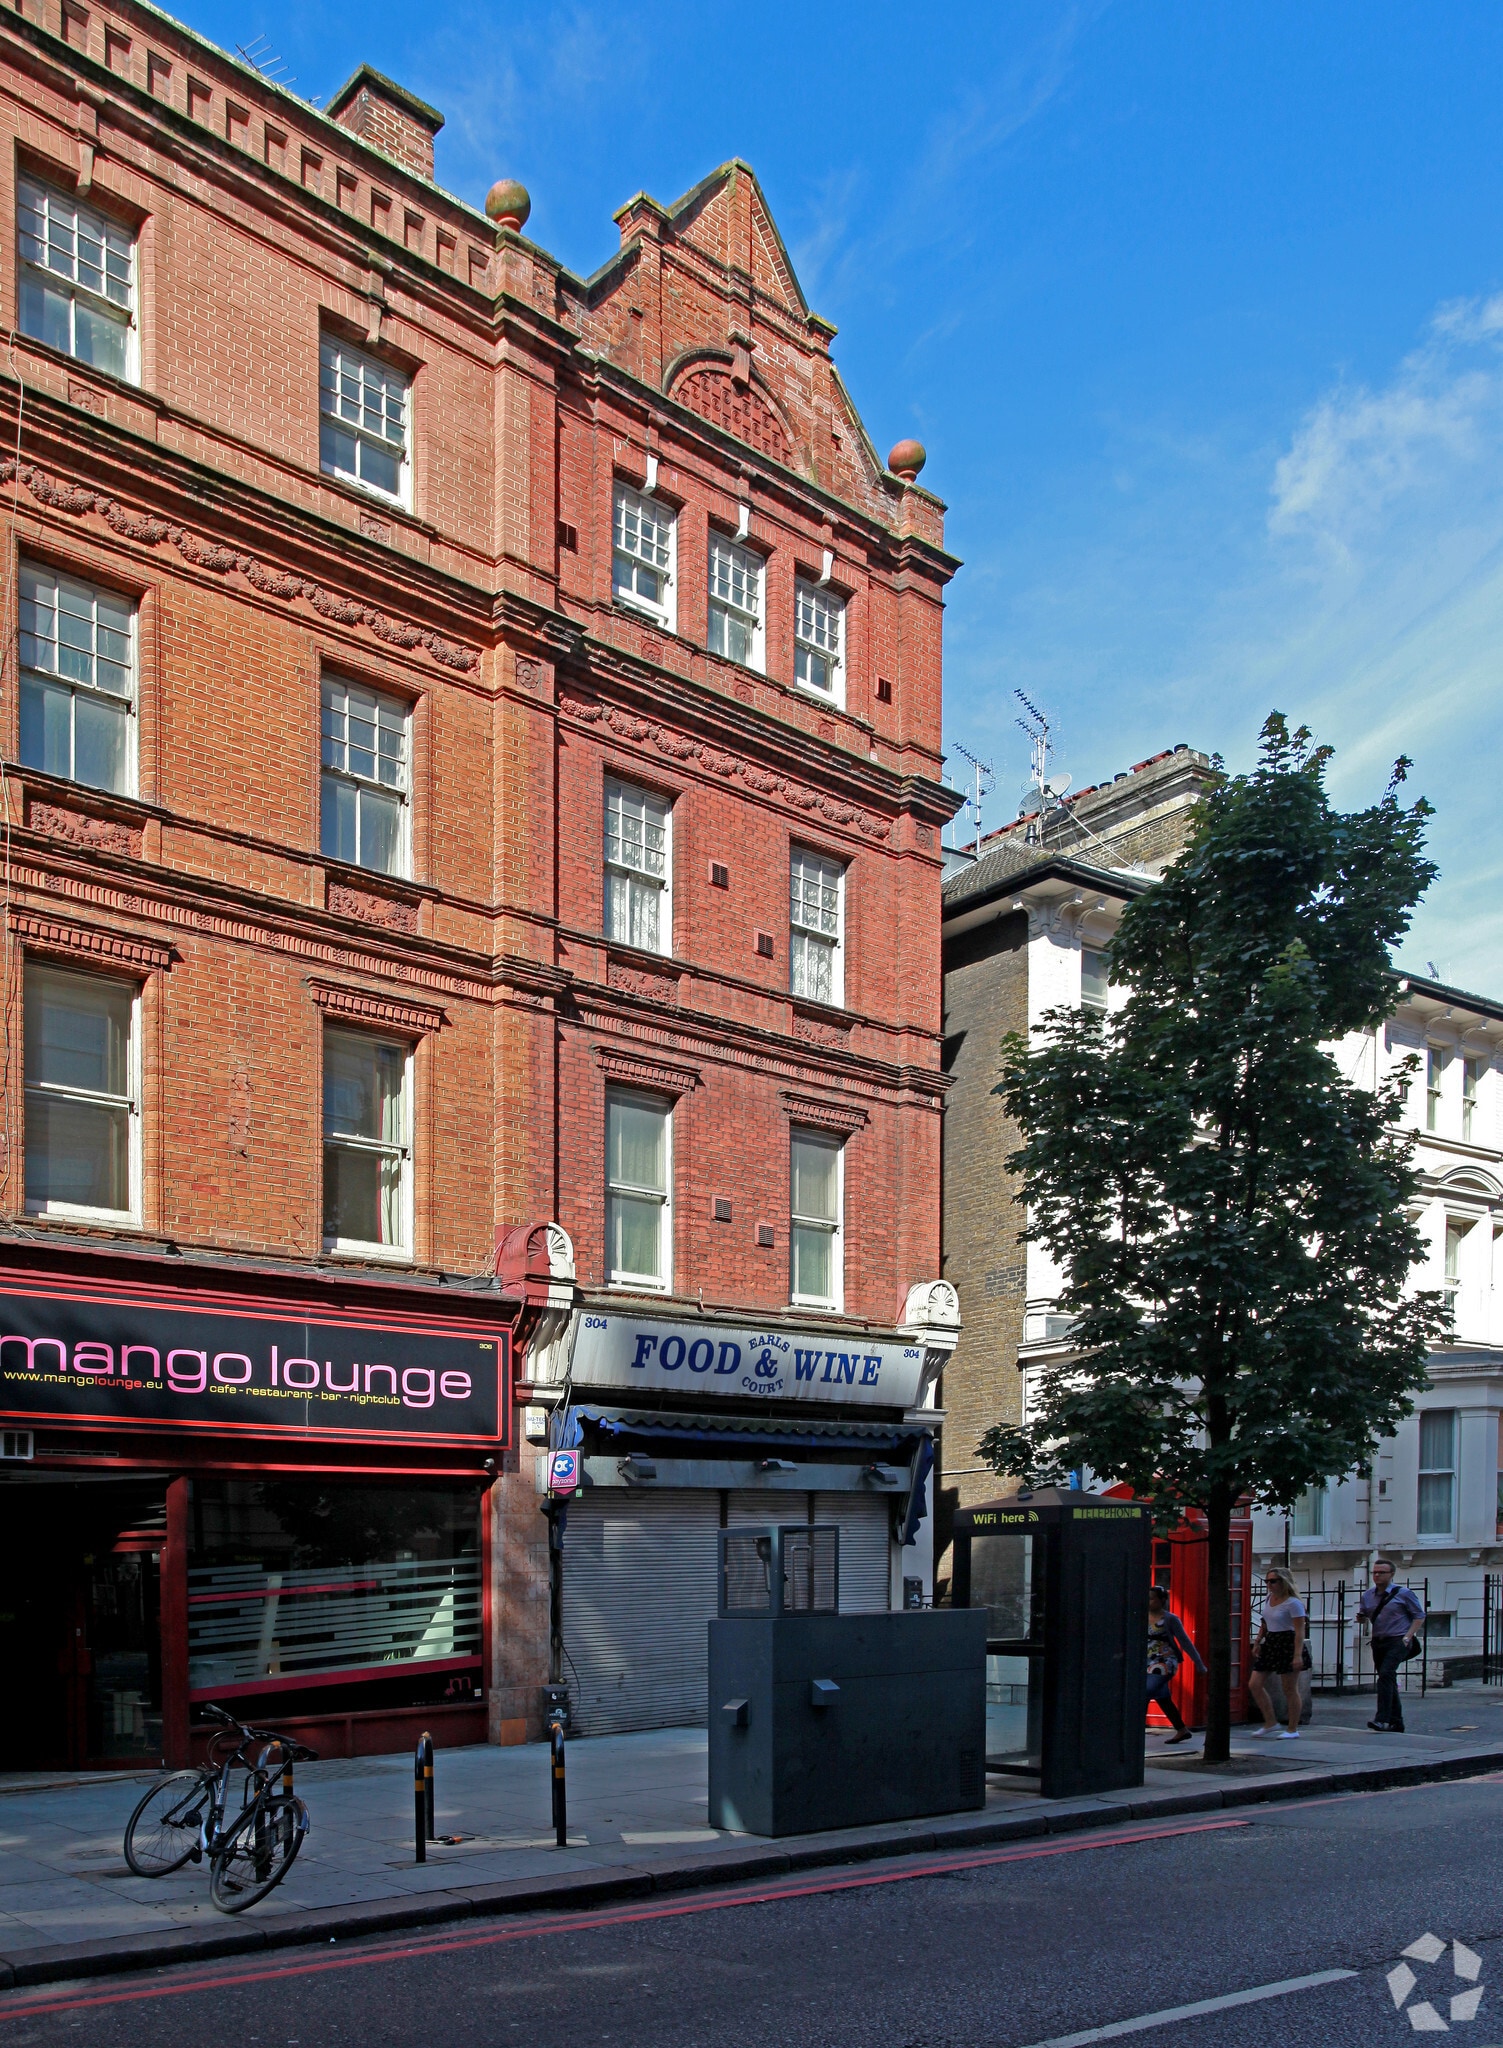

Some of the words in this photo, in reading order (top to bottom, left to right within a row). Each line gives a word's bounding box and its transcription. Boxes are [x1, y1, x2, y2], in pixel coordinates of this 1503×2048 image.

[585, 1317, 608, 1329] 304
[749, 1334, 791, 1353] EARLS
[631, 1334, 742, 1375] FOOD
[755, 1348, 778, 1379] &
[793, 1348, 882, 1386] WINE
[903, 1348, 920, 1359] 304
[0, 1334, 252, 1394] mango
[271, 1345, 472, 1409] lounge
[4, 1371, 163, 1390] www.mangolounge.eu
[742, 1376, 784, 1394] COURT
[209, 1384, 237, 1394] cafe
[246, 1387, 313, 1400] restaurant
[321, 1391, 342, 1401] bar
[350, 1394, 400, 1405] nightclub
[973, 1513, 997, 1524] WiFi
[1001, 1513, 1025, 1523] here
[1080, 1507, 1136, 1519] TELEPHONE
